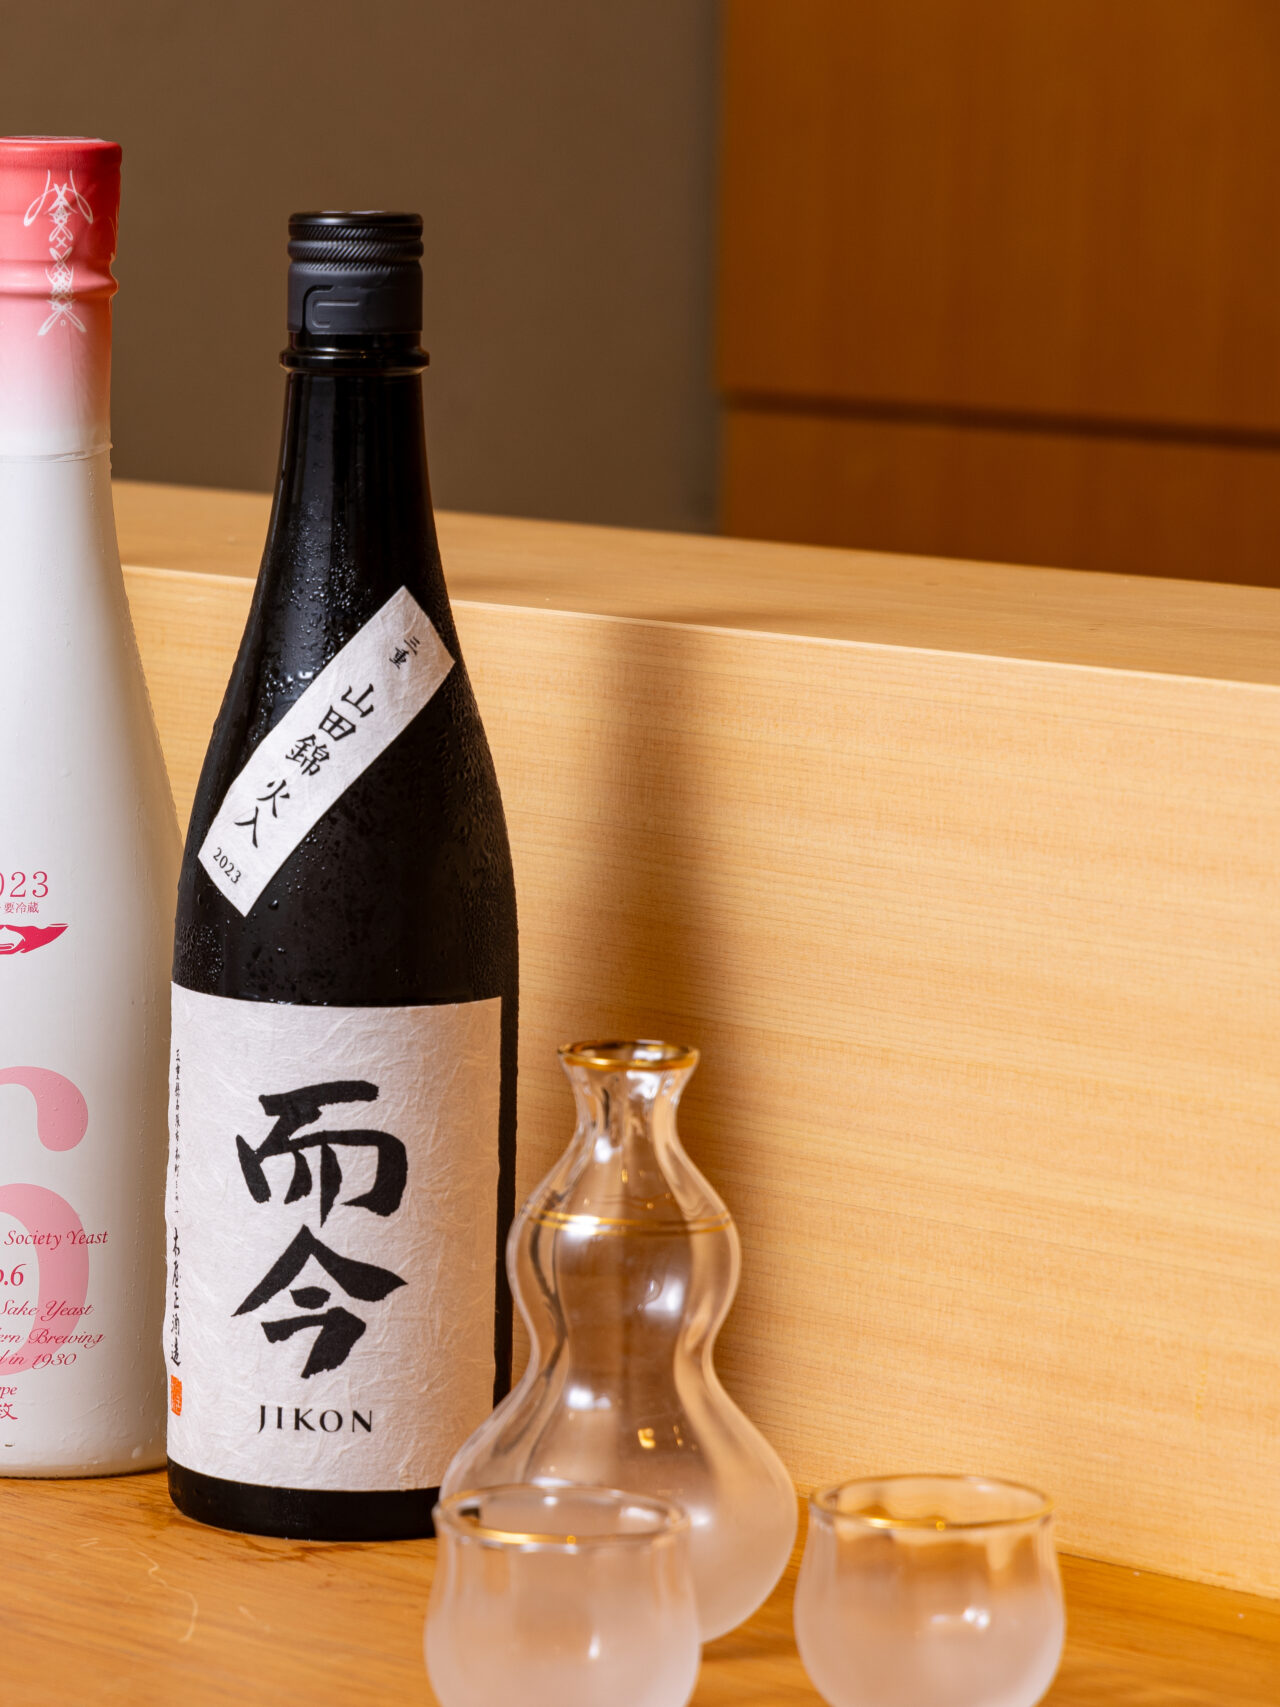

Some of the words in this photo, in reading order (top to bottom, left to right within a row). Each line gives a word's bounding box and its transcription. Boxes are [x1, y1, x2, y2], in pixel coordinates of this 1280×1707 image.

[388, 636, 420, 669] 三重
[285, 683, 374, 777] 山田錦
[234, 779, 290, 848] 火入
[213, 847, 242, 884] 2023
[4, 1230, 62, 1250] Society
[66, 1230, 109, 1245] Yeast
[231, 1080, 408, 1379] 而今
[40, 1300, 95, 1322] Yeast
[28, 1328, 105, 1349] Brewing
[8, 1351, 26, 1366] in
[31, 1353, 77, 1369] 1930
[258, 1405, 373, 1433] JIKON
